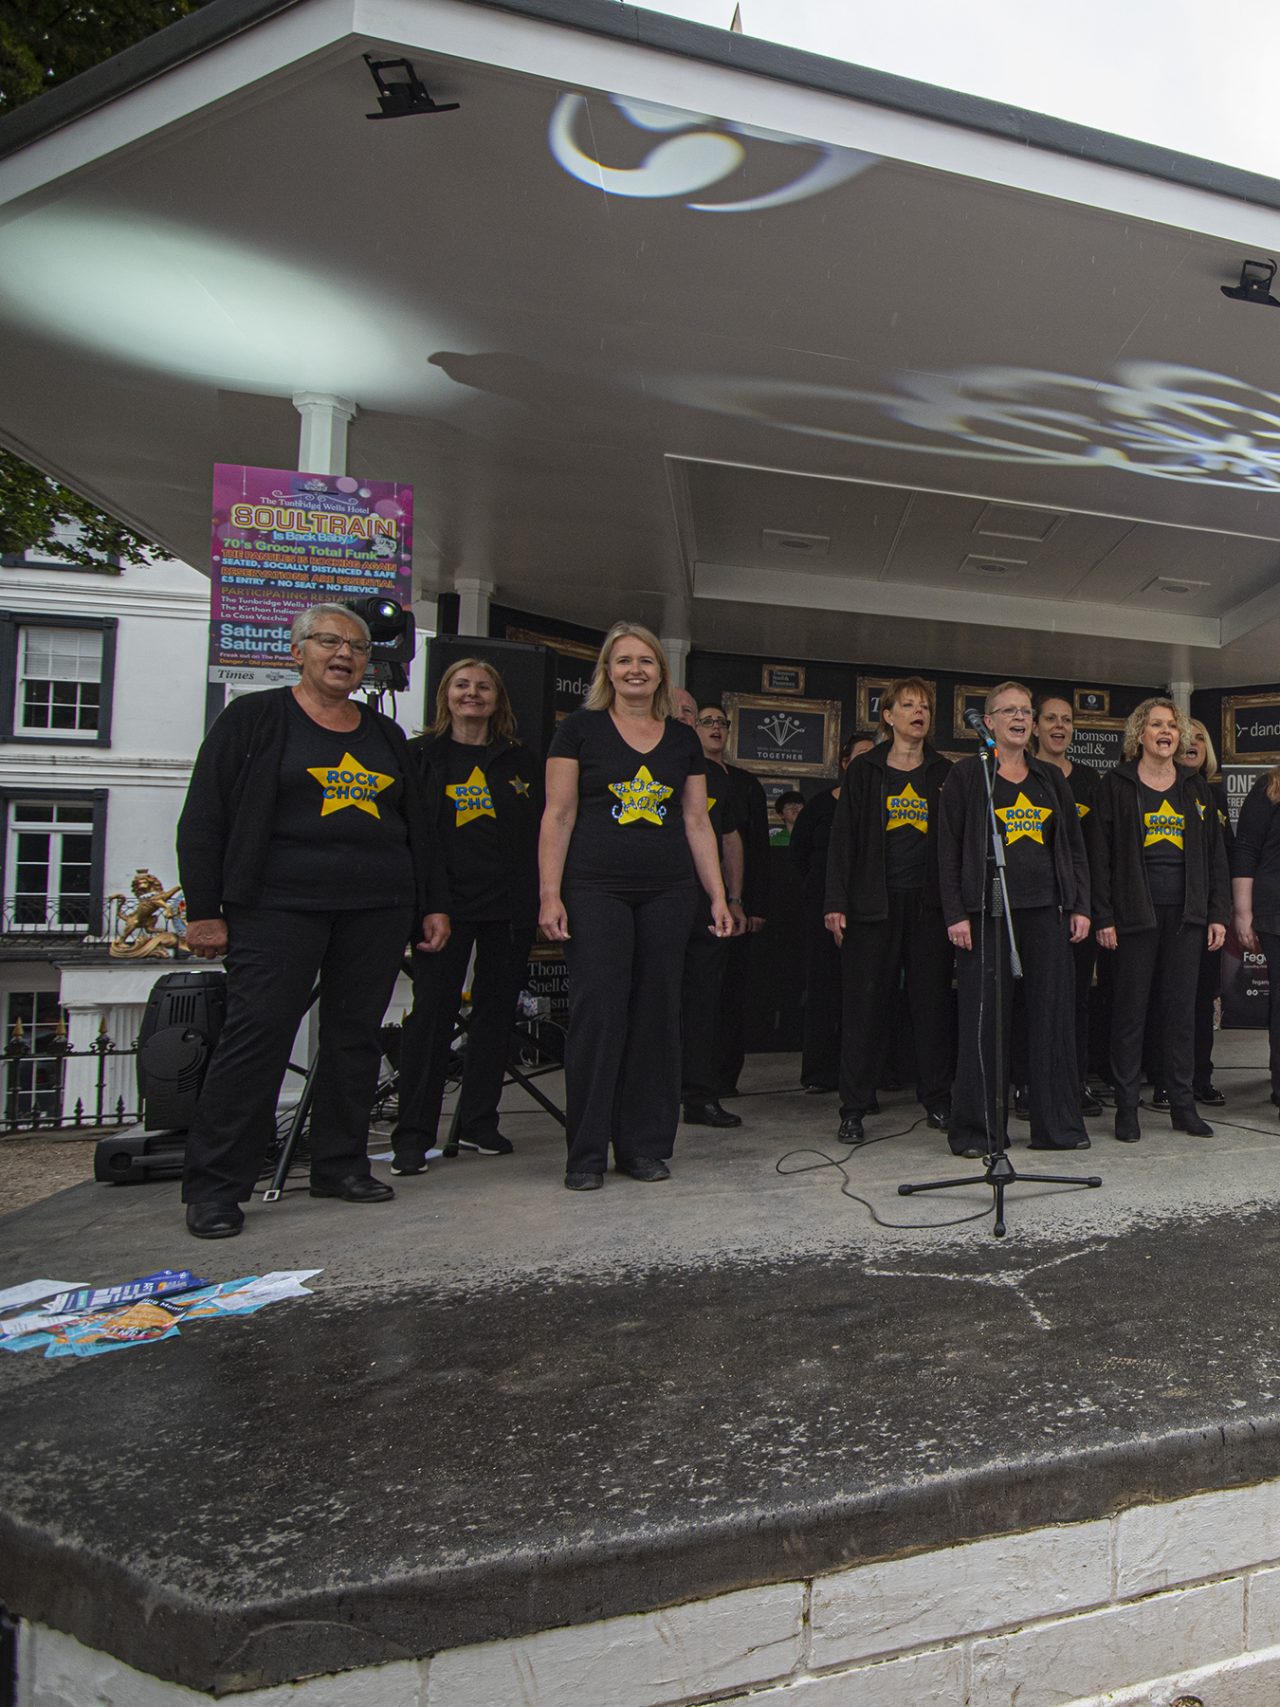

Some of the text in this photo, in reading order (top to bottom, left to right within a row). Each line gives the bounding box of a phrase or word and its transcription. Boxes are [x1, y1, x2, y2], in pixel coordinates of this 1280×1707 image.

[260, 496, 370, 515] The Tunbridge Wells Hotel
[232, 504, 396, 539] SOULTRAIN
[273, 530, 285, 541] Is
[287, 531, 317, 542] Back
[223, 538, 378, 561] 70's Groove Total Funk
[222, 558, 396, 579] SEATED, SOCIALLY DISTANCED & SAFE
[221, 575, 379, 595] £5 ENTRY NO SEAT NO SERVICE
[221, 586, 308, 601] PARTICIPATING
[221, 596, 237, 604] The
[238, 597, 282, 608] Tunbridge
[282, 600, 305, 608] Wells
[234, 613, 255, 621] Casa
[255, 614, 288, 622] Vecchia
[220, 623, 292, 639] Saturda
[220, 637, 292, 653] Saturda
[217, 669, 255, 681] Times
[556, 677, 591, 696] anda
[1072, 729, 1119, 742] homson
[757, 752, 803, 761] TOGETHER
[1094, 743, 1106, 756] &
[327, 770, 380, 788] ROCK
[322, 786, 378, 802] CHOIR
[455, 785, 491, 797] ROC
[613, 777, 669, 799] ROCK
[454, 797, 494, 811] CHO
[611, 797, 667, 820] CHOIR
[890, 797, 928, 811] ROCK
[1006, 808, 1042, 820] ROCK
[1005, 821, 1043, 833] CHOIR
[1149, 815, 1184, 828] ROCK
[1145, 825, 1184, 837] CHOIR
[1243, 951, 1267, 965] Feg
[527, 962, 569, 976] Thom
[528, 978, 560, 993] Snell
